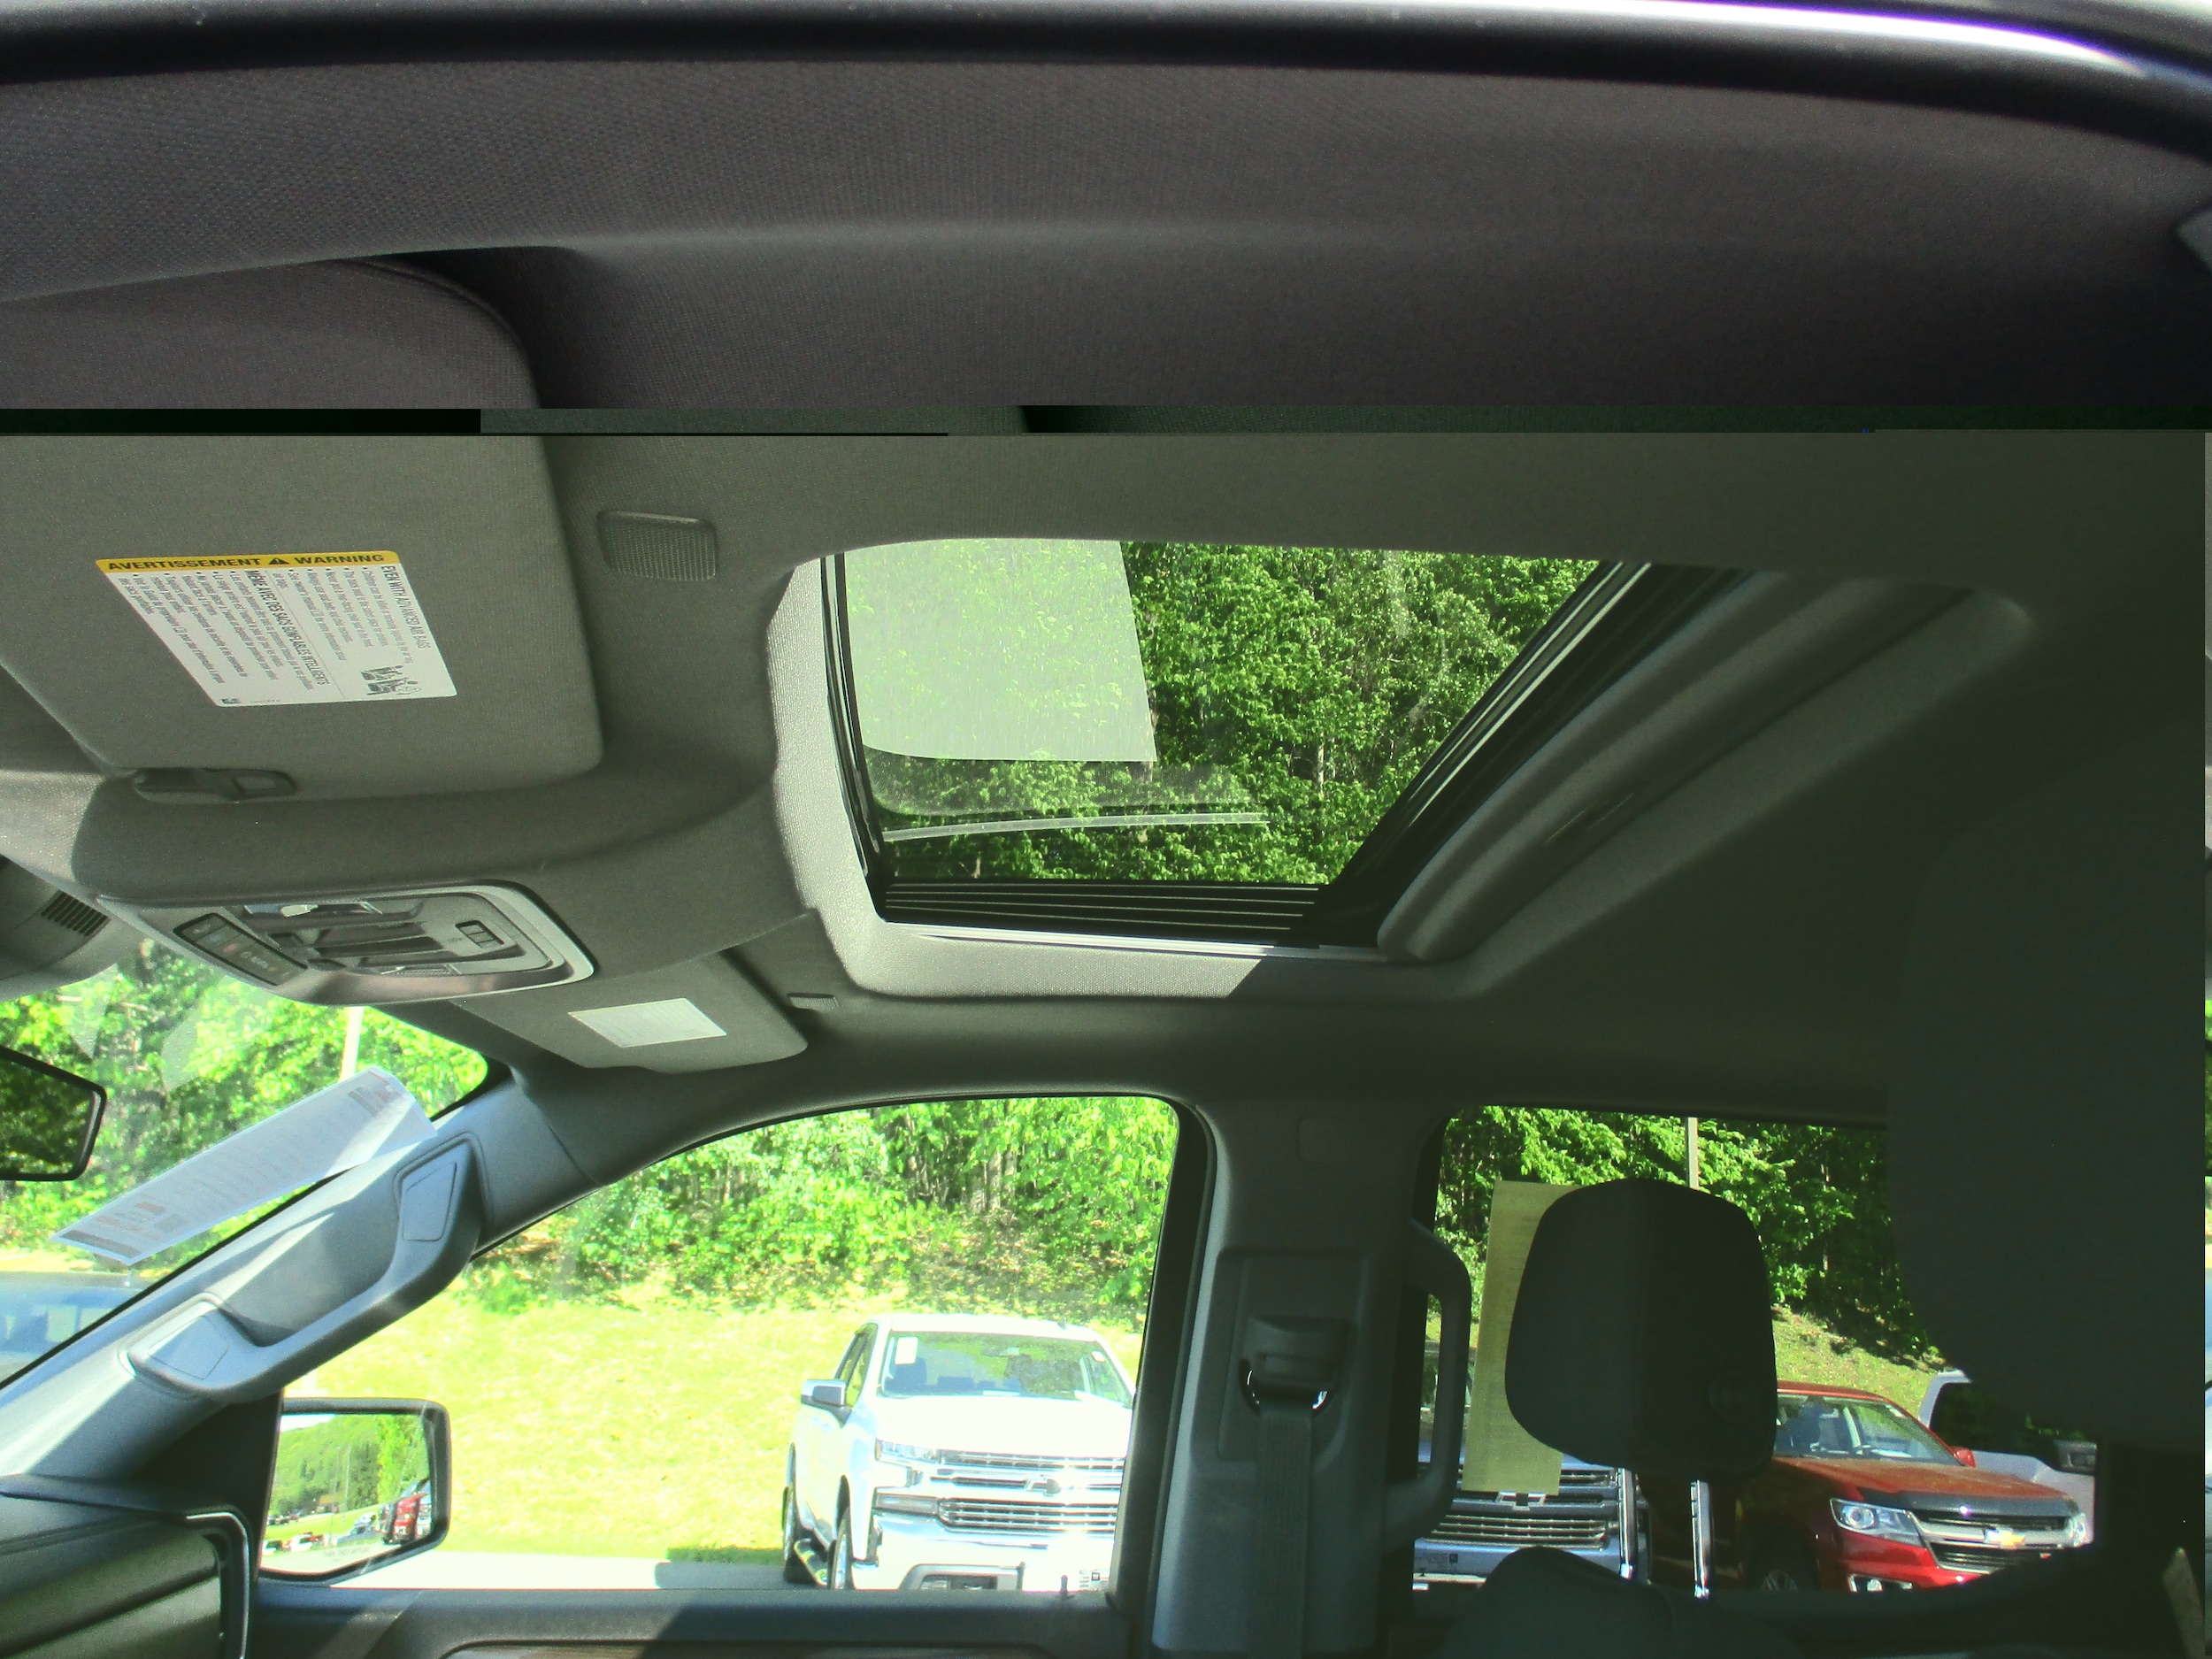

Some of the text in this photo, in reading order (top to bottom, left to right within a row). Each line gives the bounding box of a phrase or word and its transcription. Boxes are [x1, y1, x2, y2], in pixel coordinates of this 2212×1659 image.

[108, 554, 384, 570] AVERTISSEMENT WARNING
[380, 565, 400, 580] EVEN
[387, 581, 407, 595] WITH
[264, 601, 285, 611] DES
